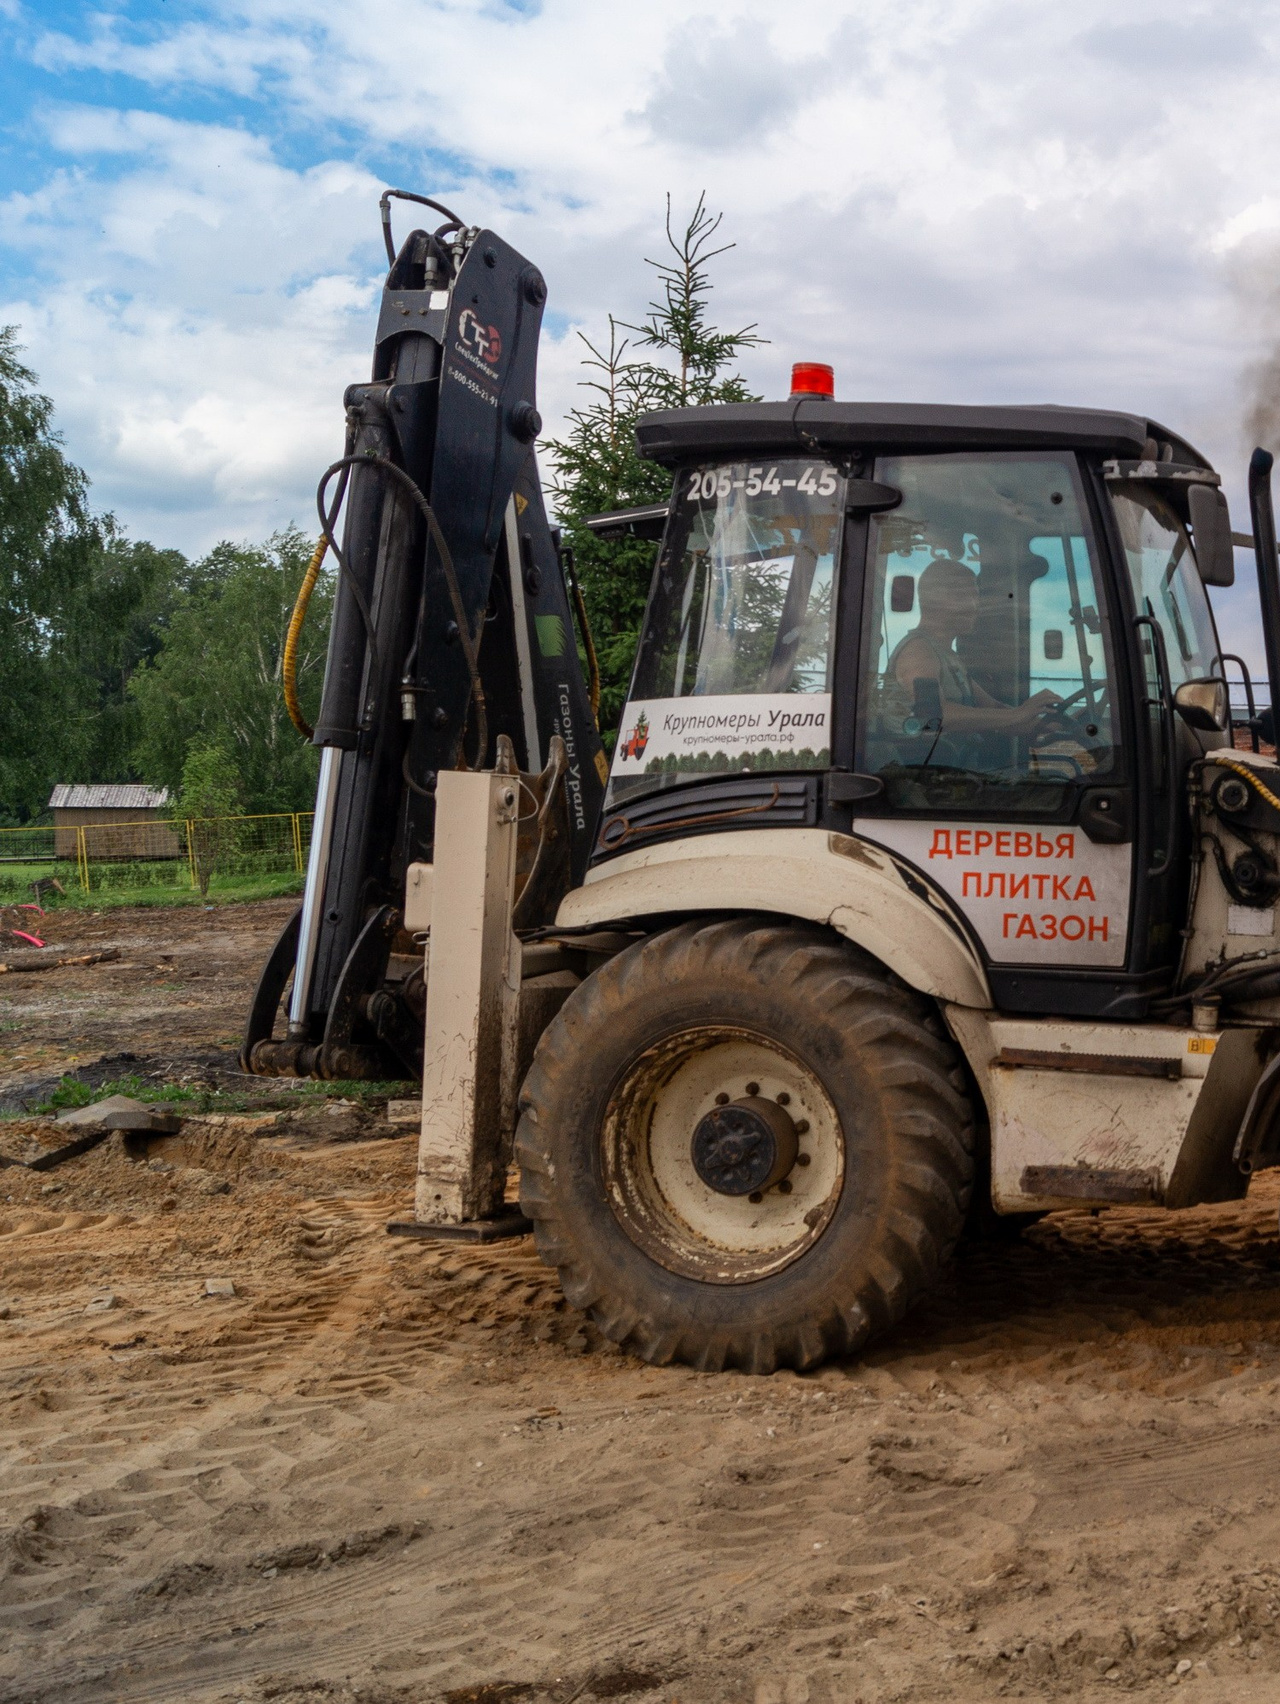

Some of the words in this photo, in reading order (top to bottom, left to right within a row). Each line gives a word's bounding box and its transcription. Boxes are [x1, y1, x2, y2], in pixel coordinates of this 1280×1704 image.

[687, 467, 838, 501] 205-54-45
[663, 714, 761, 735] Крупномеры
[768, 710, 825, 732] Урала
[558, 683, 575, 757] Газоны
[569, 763, 586, 830] Урала
[929, 829, 1075, 859] ДЕРЕВЬЯ
[961, 872, 1096, 901] ПЛИТКА
[1002, 913, 1109, 942] ГАЗОН
